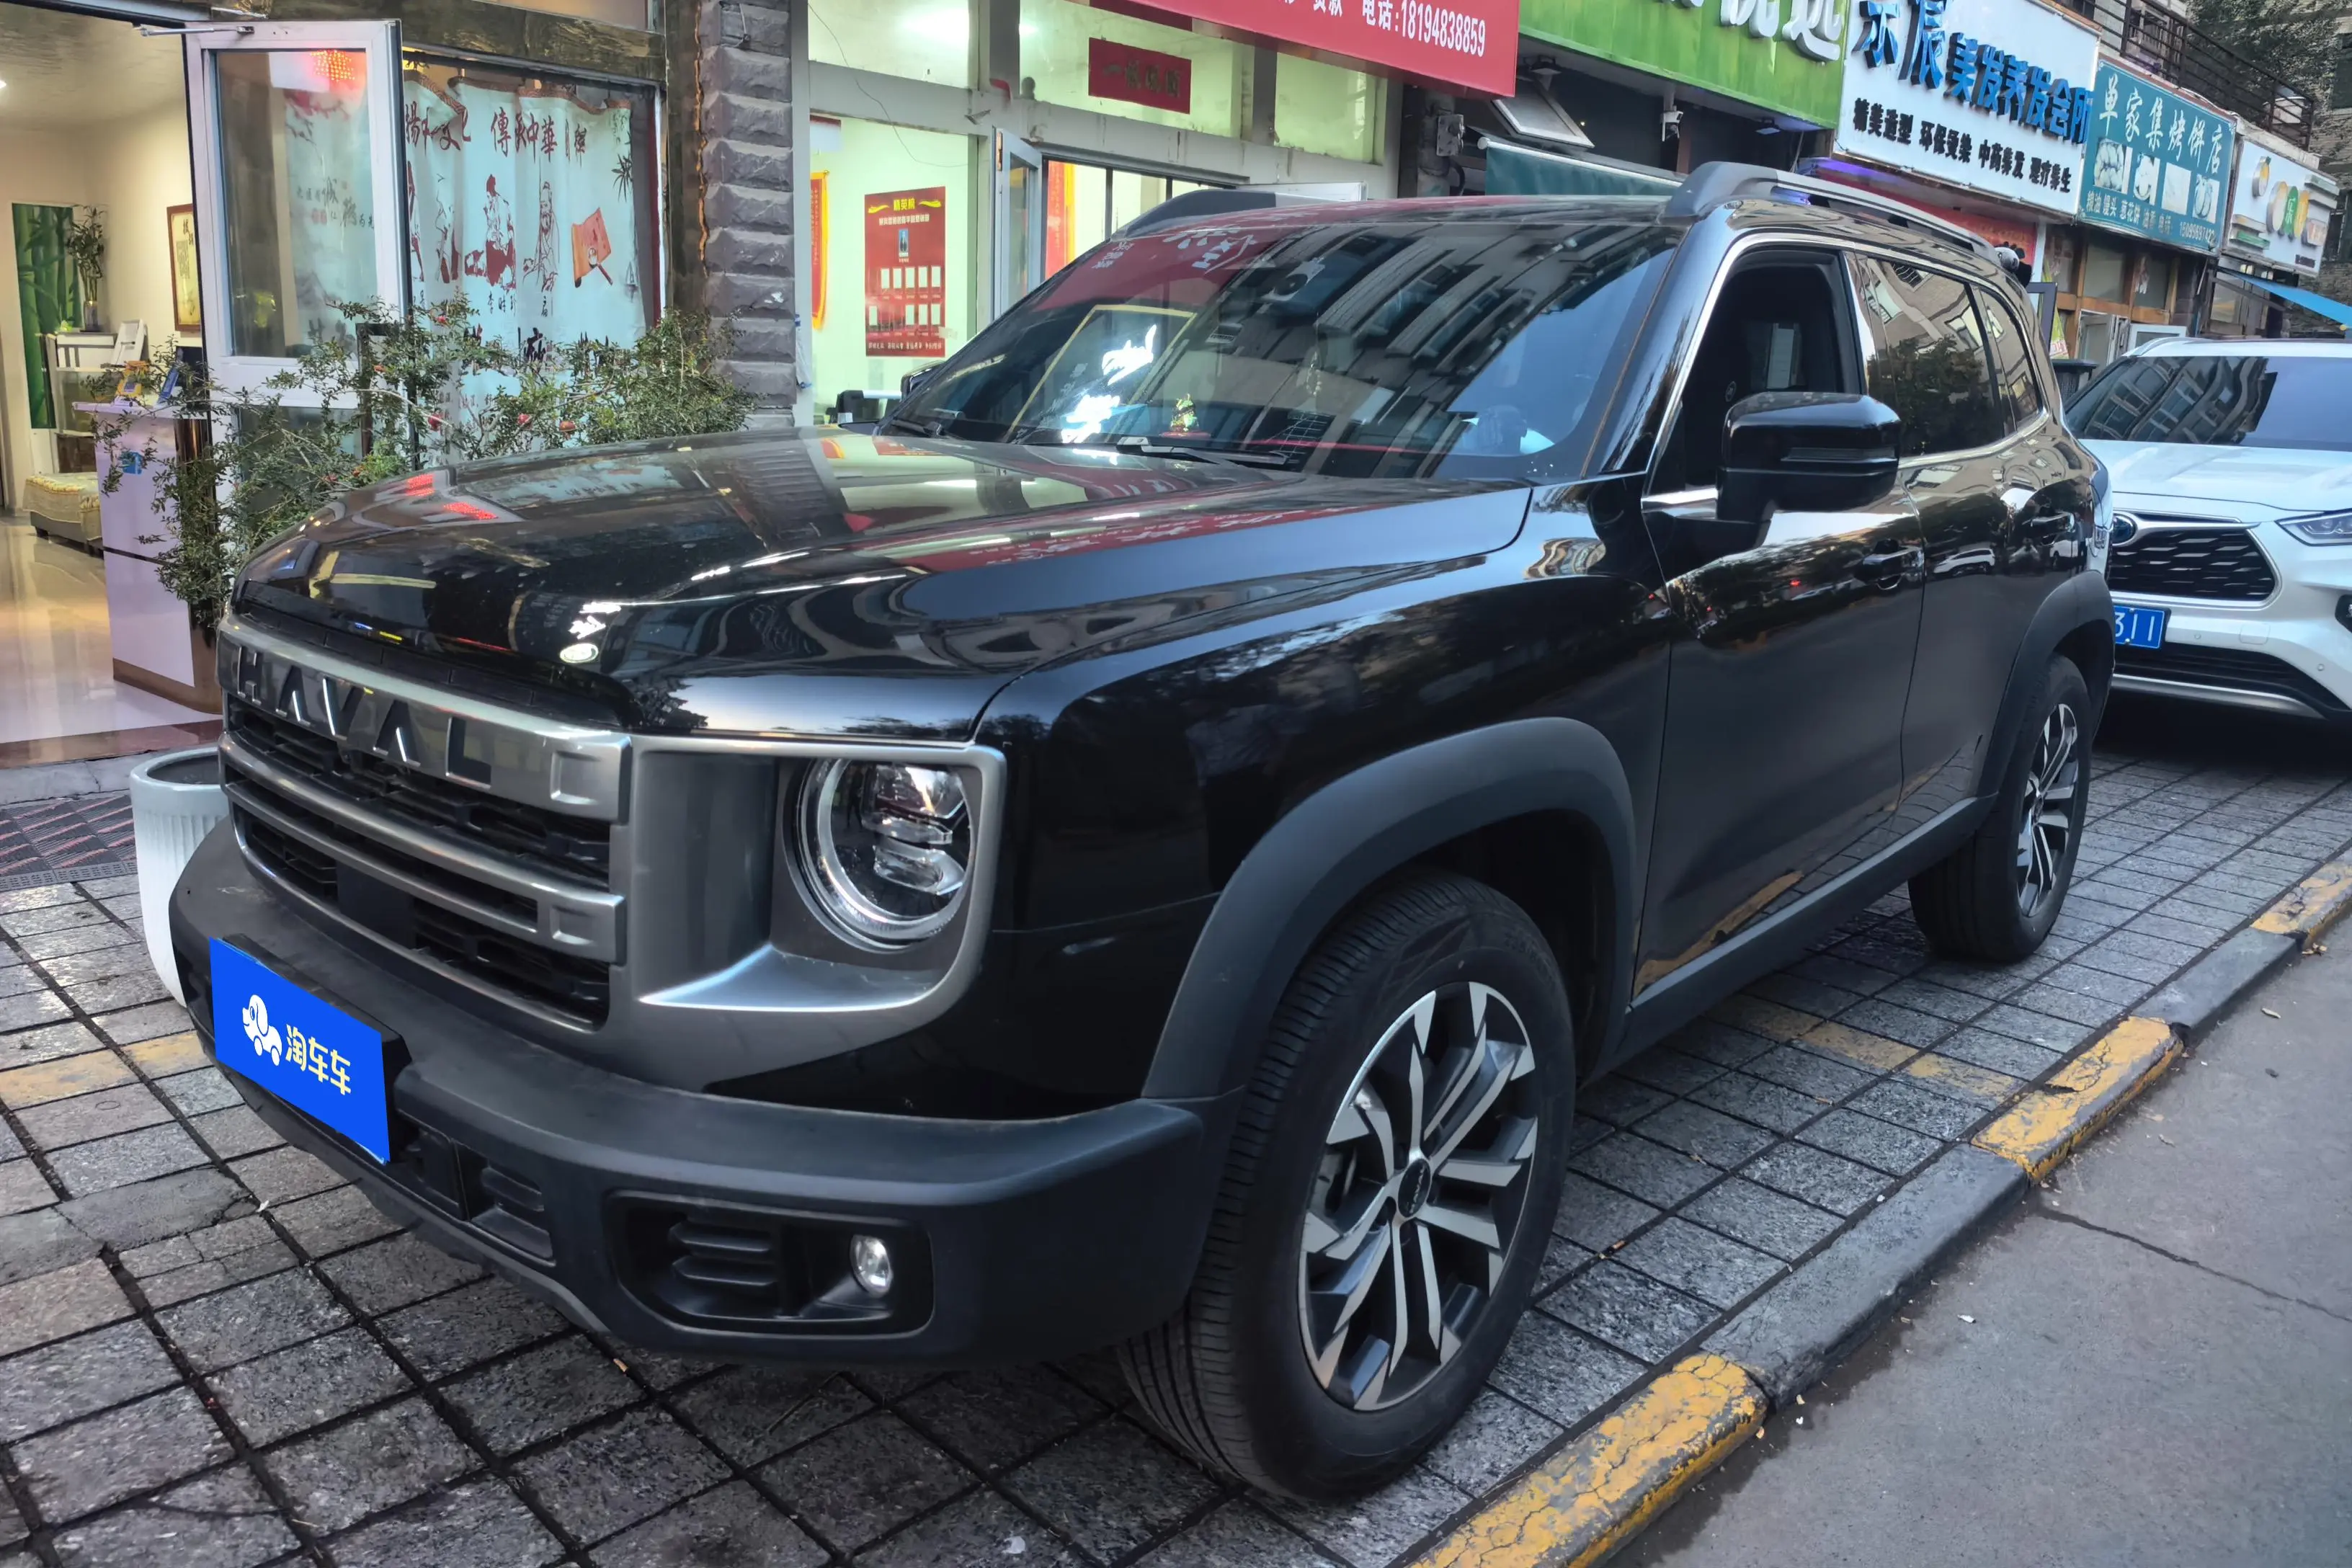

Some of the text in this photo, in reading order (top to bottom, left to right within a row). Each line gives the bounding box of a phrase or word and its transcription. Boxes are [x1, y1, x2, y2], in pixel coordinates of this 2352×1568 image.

[1943, 32, 2094, 146] 美发养发会所
[2098, 73, 2223, 175] 单家集烤饼店
[1853, 97, 1914, 145] 精美造型
[1978, 138, 2026, 179] 中药养发
[2028, 156, 2072, 193] 理疗养生
[2102, 192, 2117, 217] 馒头
[237, 646, 492, 790] HAVAL
